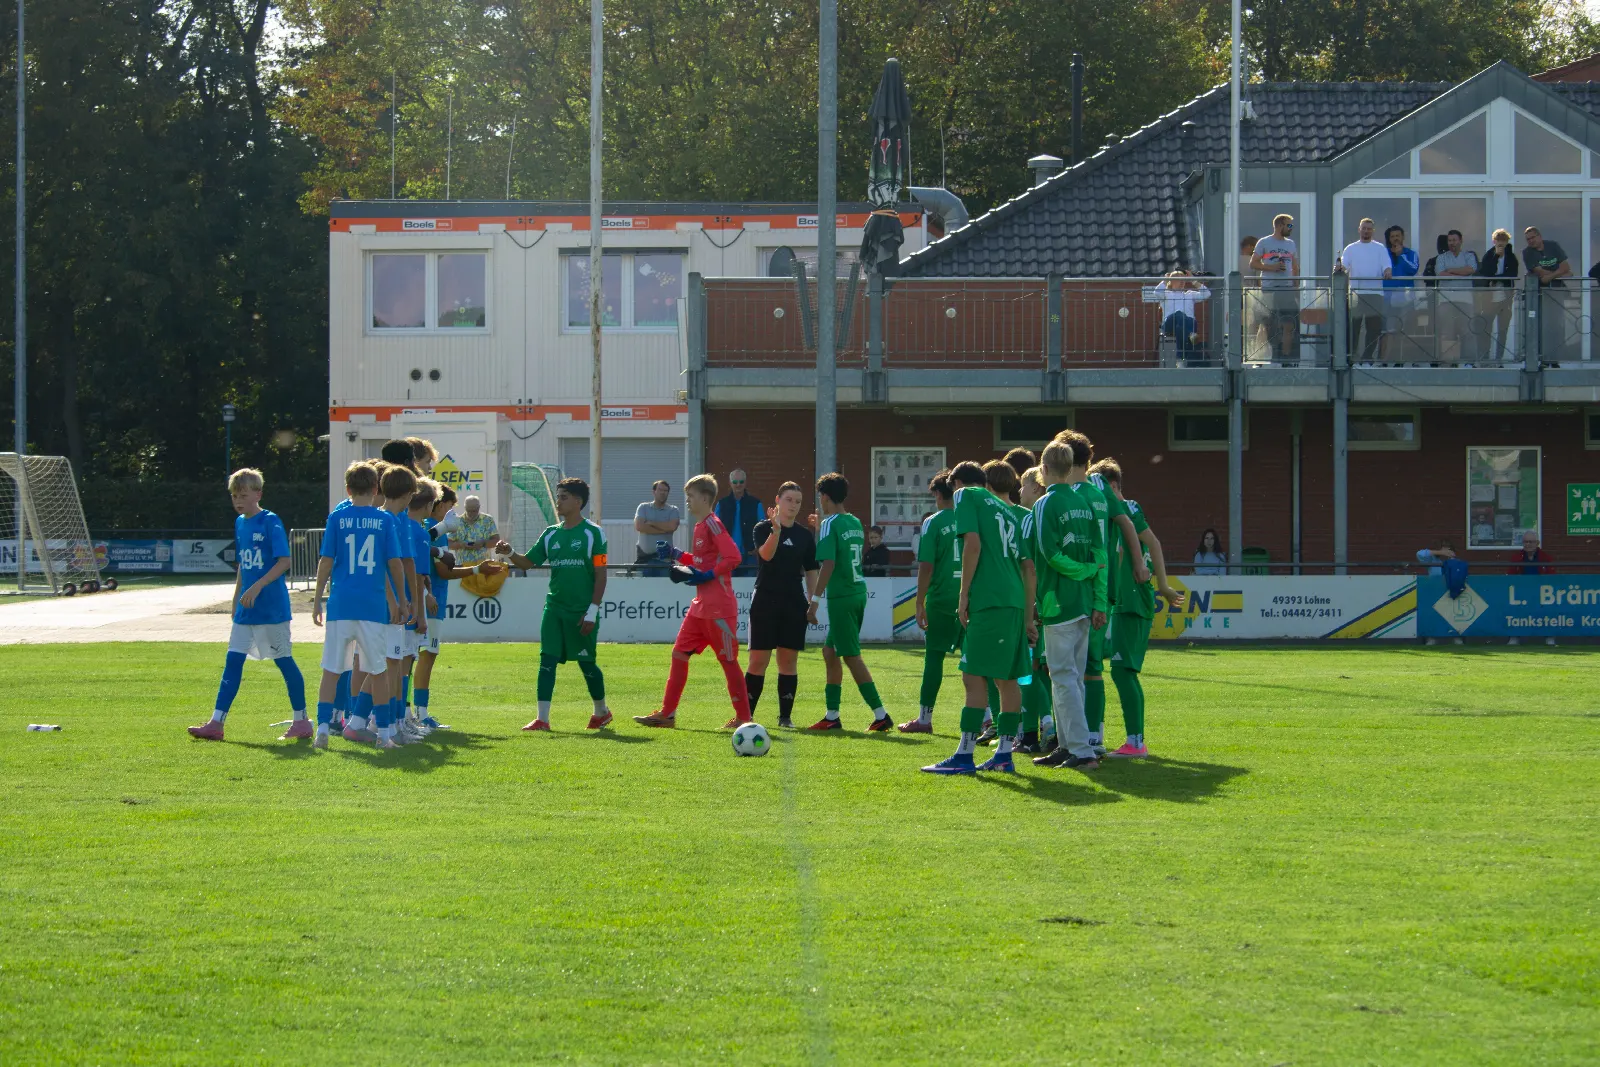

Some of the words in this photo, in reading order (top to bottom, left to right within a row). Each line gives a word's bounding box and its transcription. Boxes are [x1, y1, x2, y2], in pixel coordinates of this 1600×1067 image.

[404, 221, 434, 229] Boels
[601, 219, 631, 227] Boels
[601, 409, 631, 417] Boels
[340, 517, 354, 530] BW
[356, 517, 384, 531] LOHNE
[344, 533, 376, 575] 14
[1272, 596, 1303, 605] 49393
[1304, 595, 1331, 605] Lohne
[1509, 585, 1527, 605] L.
[1260, 608, 1280, 618] Tel.:
[1281, 608, 1342, 619] 04442/3411
[1505, 615, 1575, 627] Tankstelle
